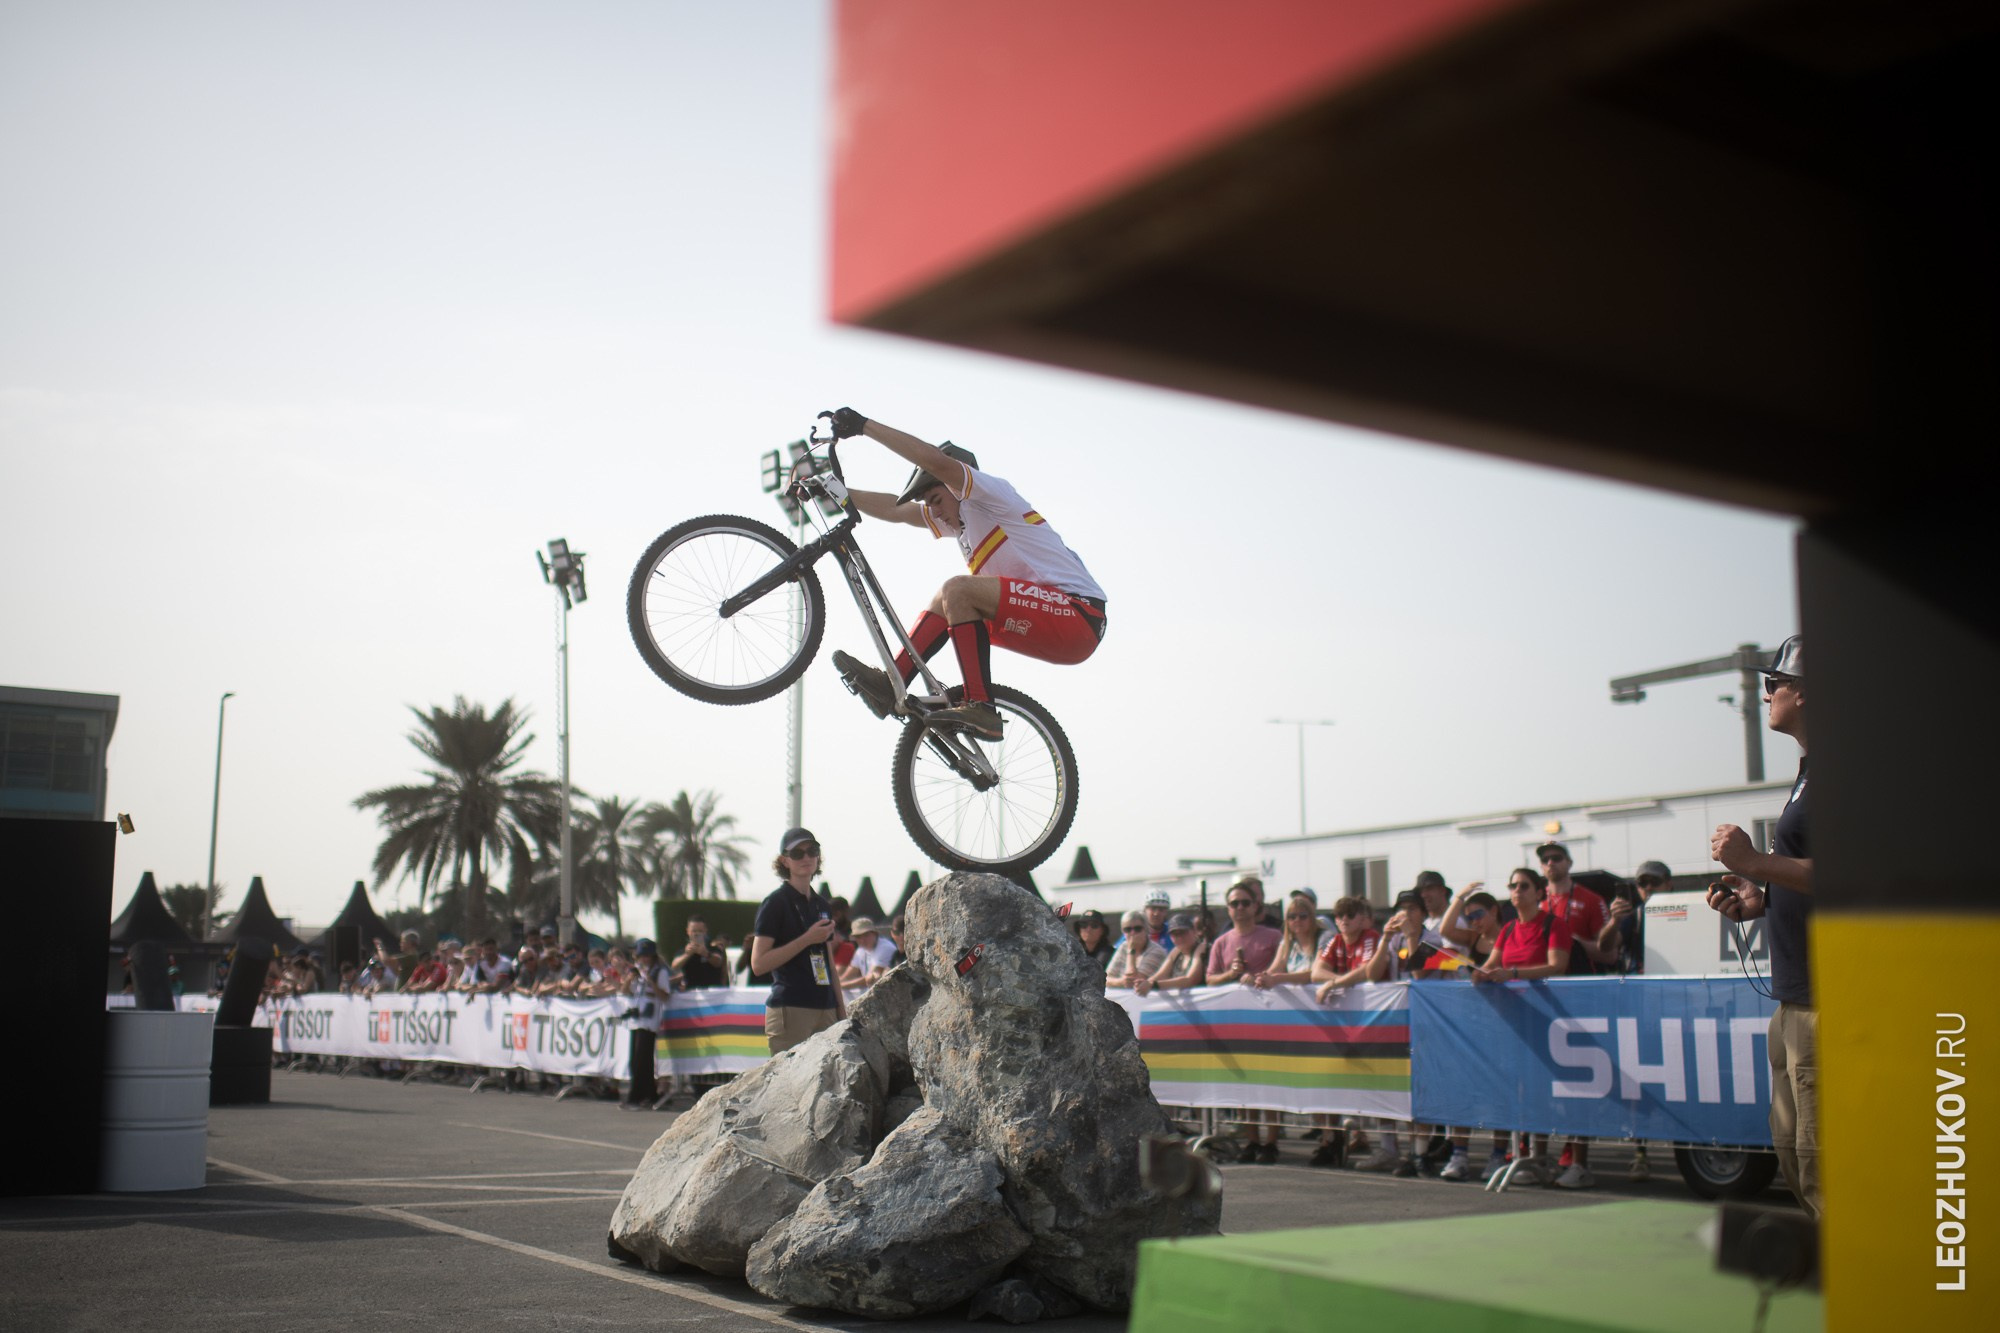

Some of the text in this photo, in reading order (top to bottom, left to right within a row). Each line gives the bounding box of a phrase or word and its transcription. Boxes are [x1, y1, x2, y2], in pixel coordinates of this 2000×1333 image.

[1008, 597, 1038, 609] BIKE
[1645, 905, 1688, 914] GENERAC
[284, 1010, 333, 1040] TISSOT
[392, 1011, 457, 1044] TISSOT
[532, 1014, 622, 1058] TISSOT
